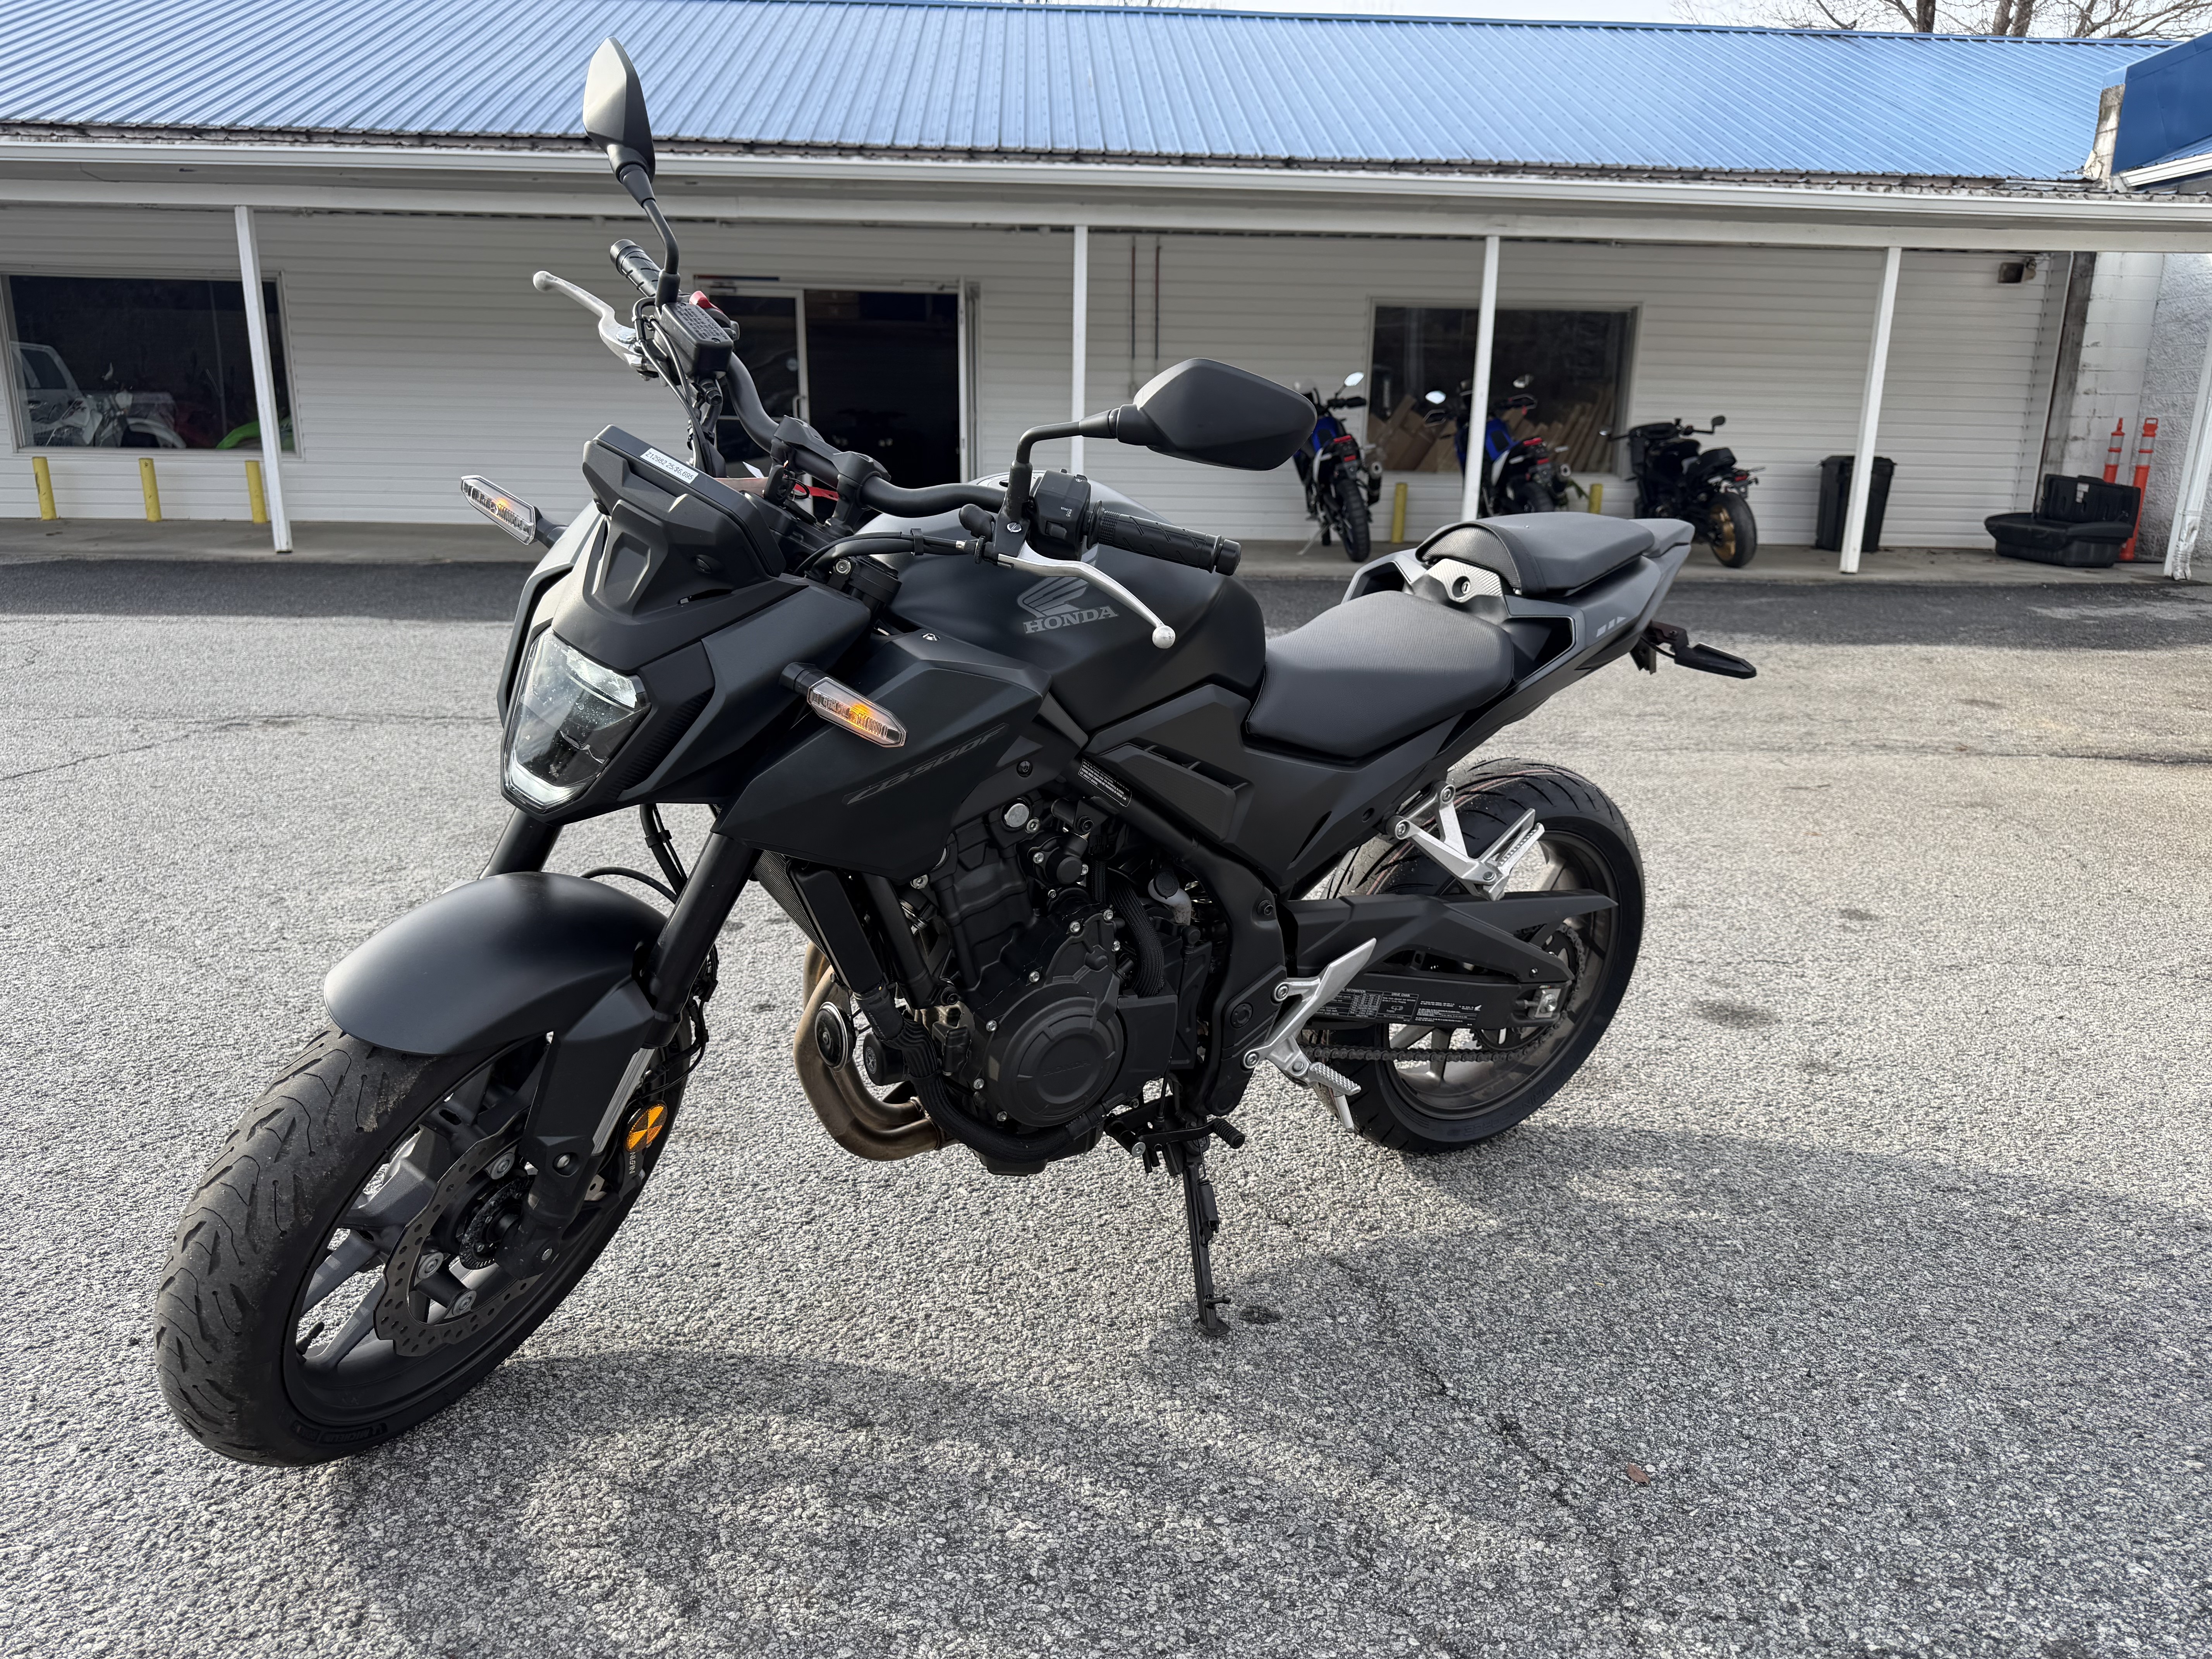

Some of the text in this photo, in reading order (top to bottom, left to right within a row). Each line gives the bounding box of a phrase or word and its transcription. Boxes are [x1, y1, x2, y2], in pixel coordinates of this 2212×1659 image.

[645, 452, 694, 480] Z12982 25/$6,695
[1023, 606, 1118, 634] HONDA
[847, 725, 1006, 805] CB500F
[1043, 1060, 1091, 1076] HONDA
[324, 1428, 370, 1442] MICHELIN
